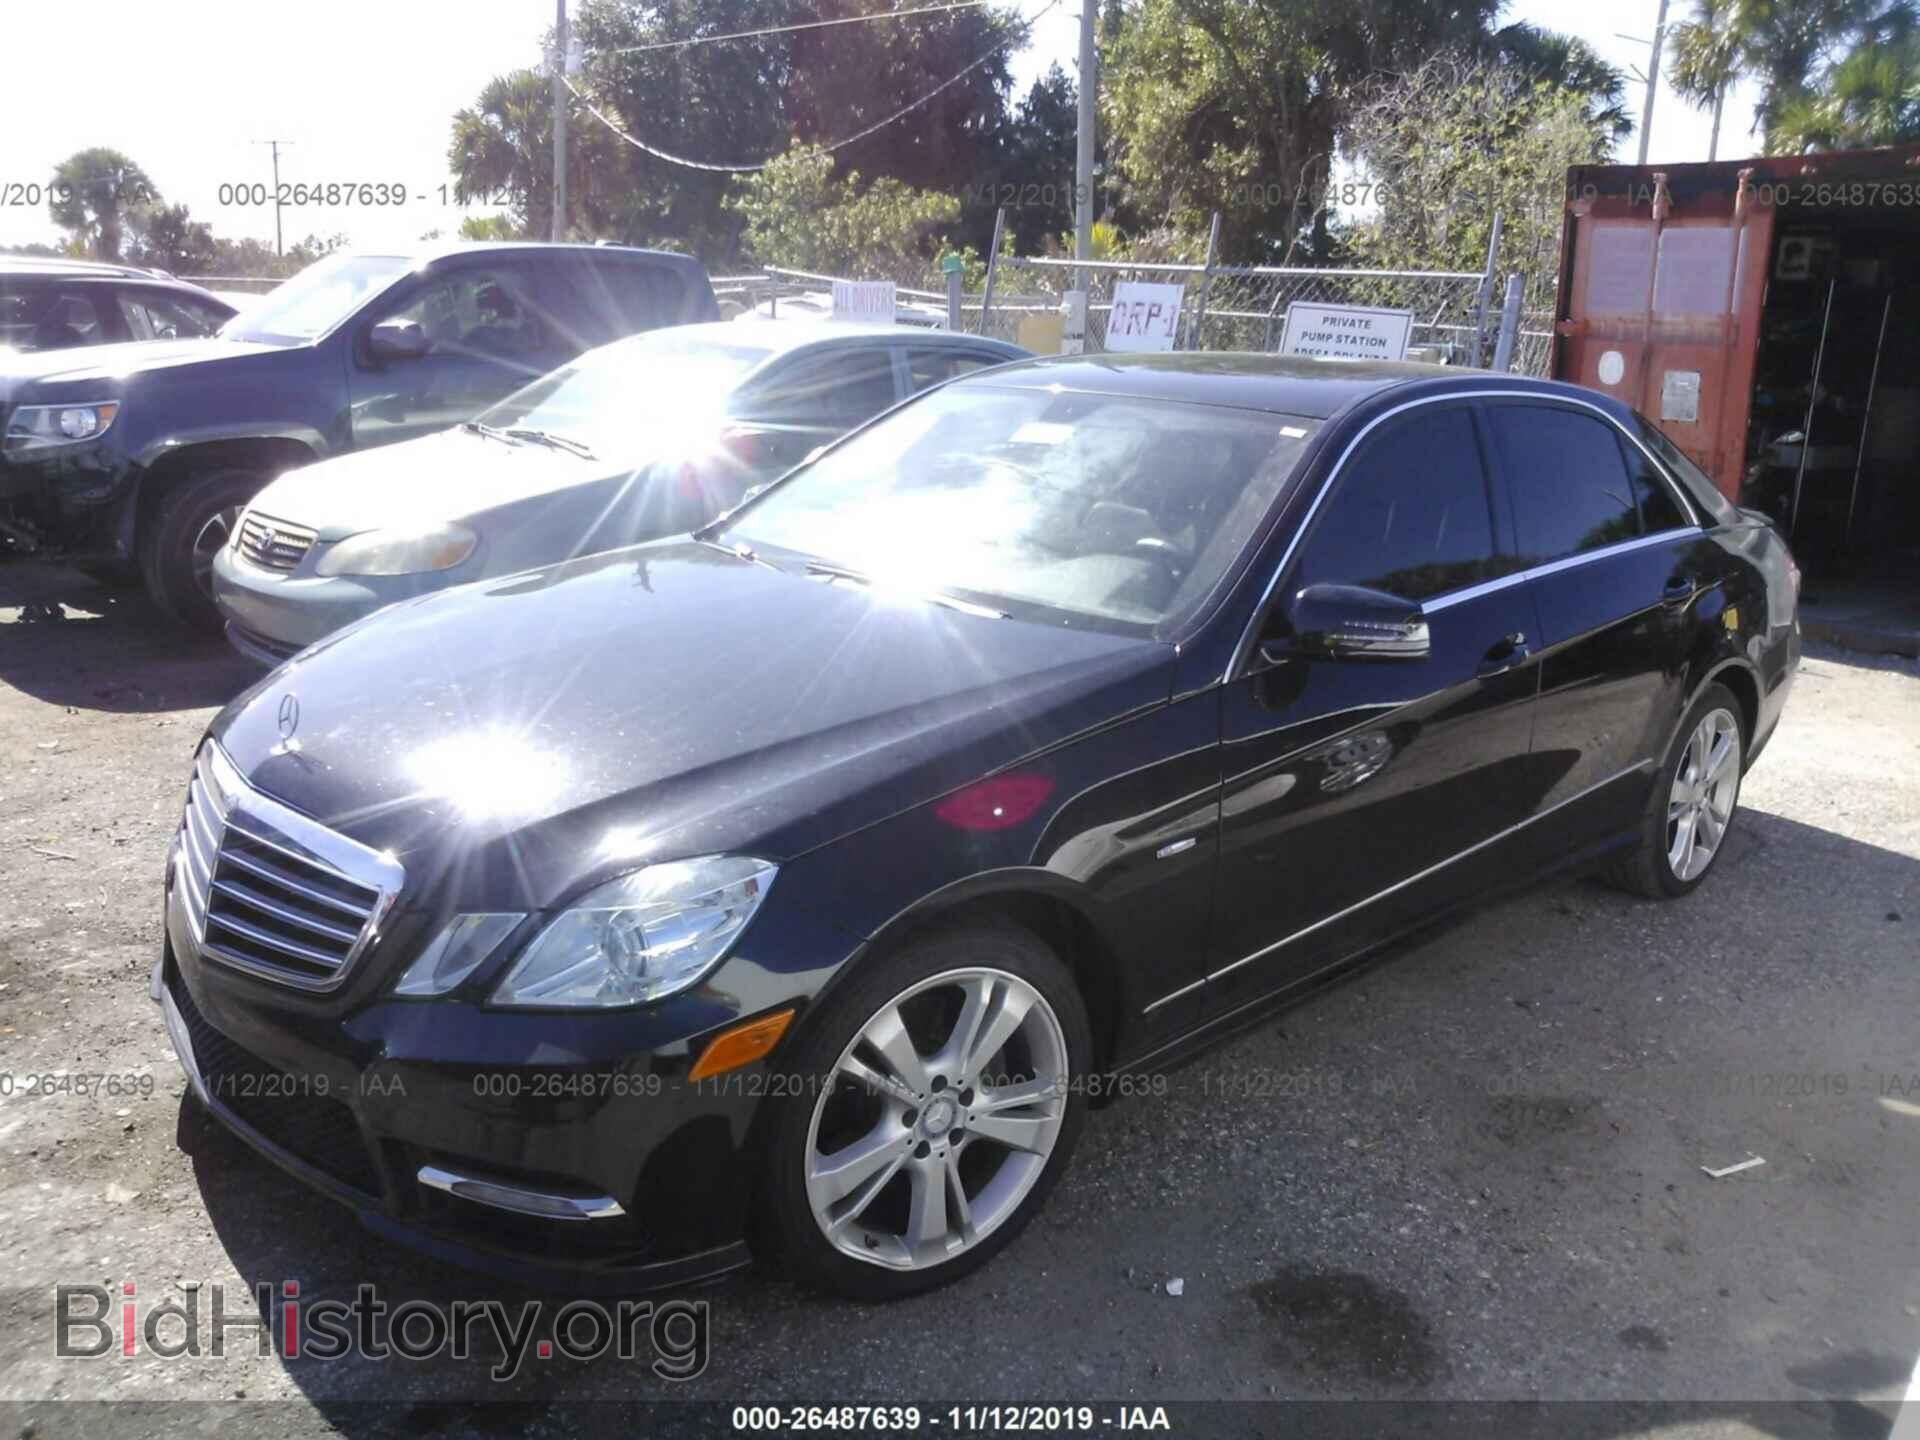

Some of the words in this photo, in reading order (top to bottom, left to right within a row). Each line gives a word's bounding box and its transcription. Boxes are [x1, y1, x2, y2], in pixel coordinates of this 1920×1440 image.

[1322, 316, 1372, 329] PRIVATE
[1301, 330, 1333, 343] PUMP
[1335, 333, 1387, 348] STATION
